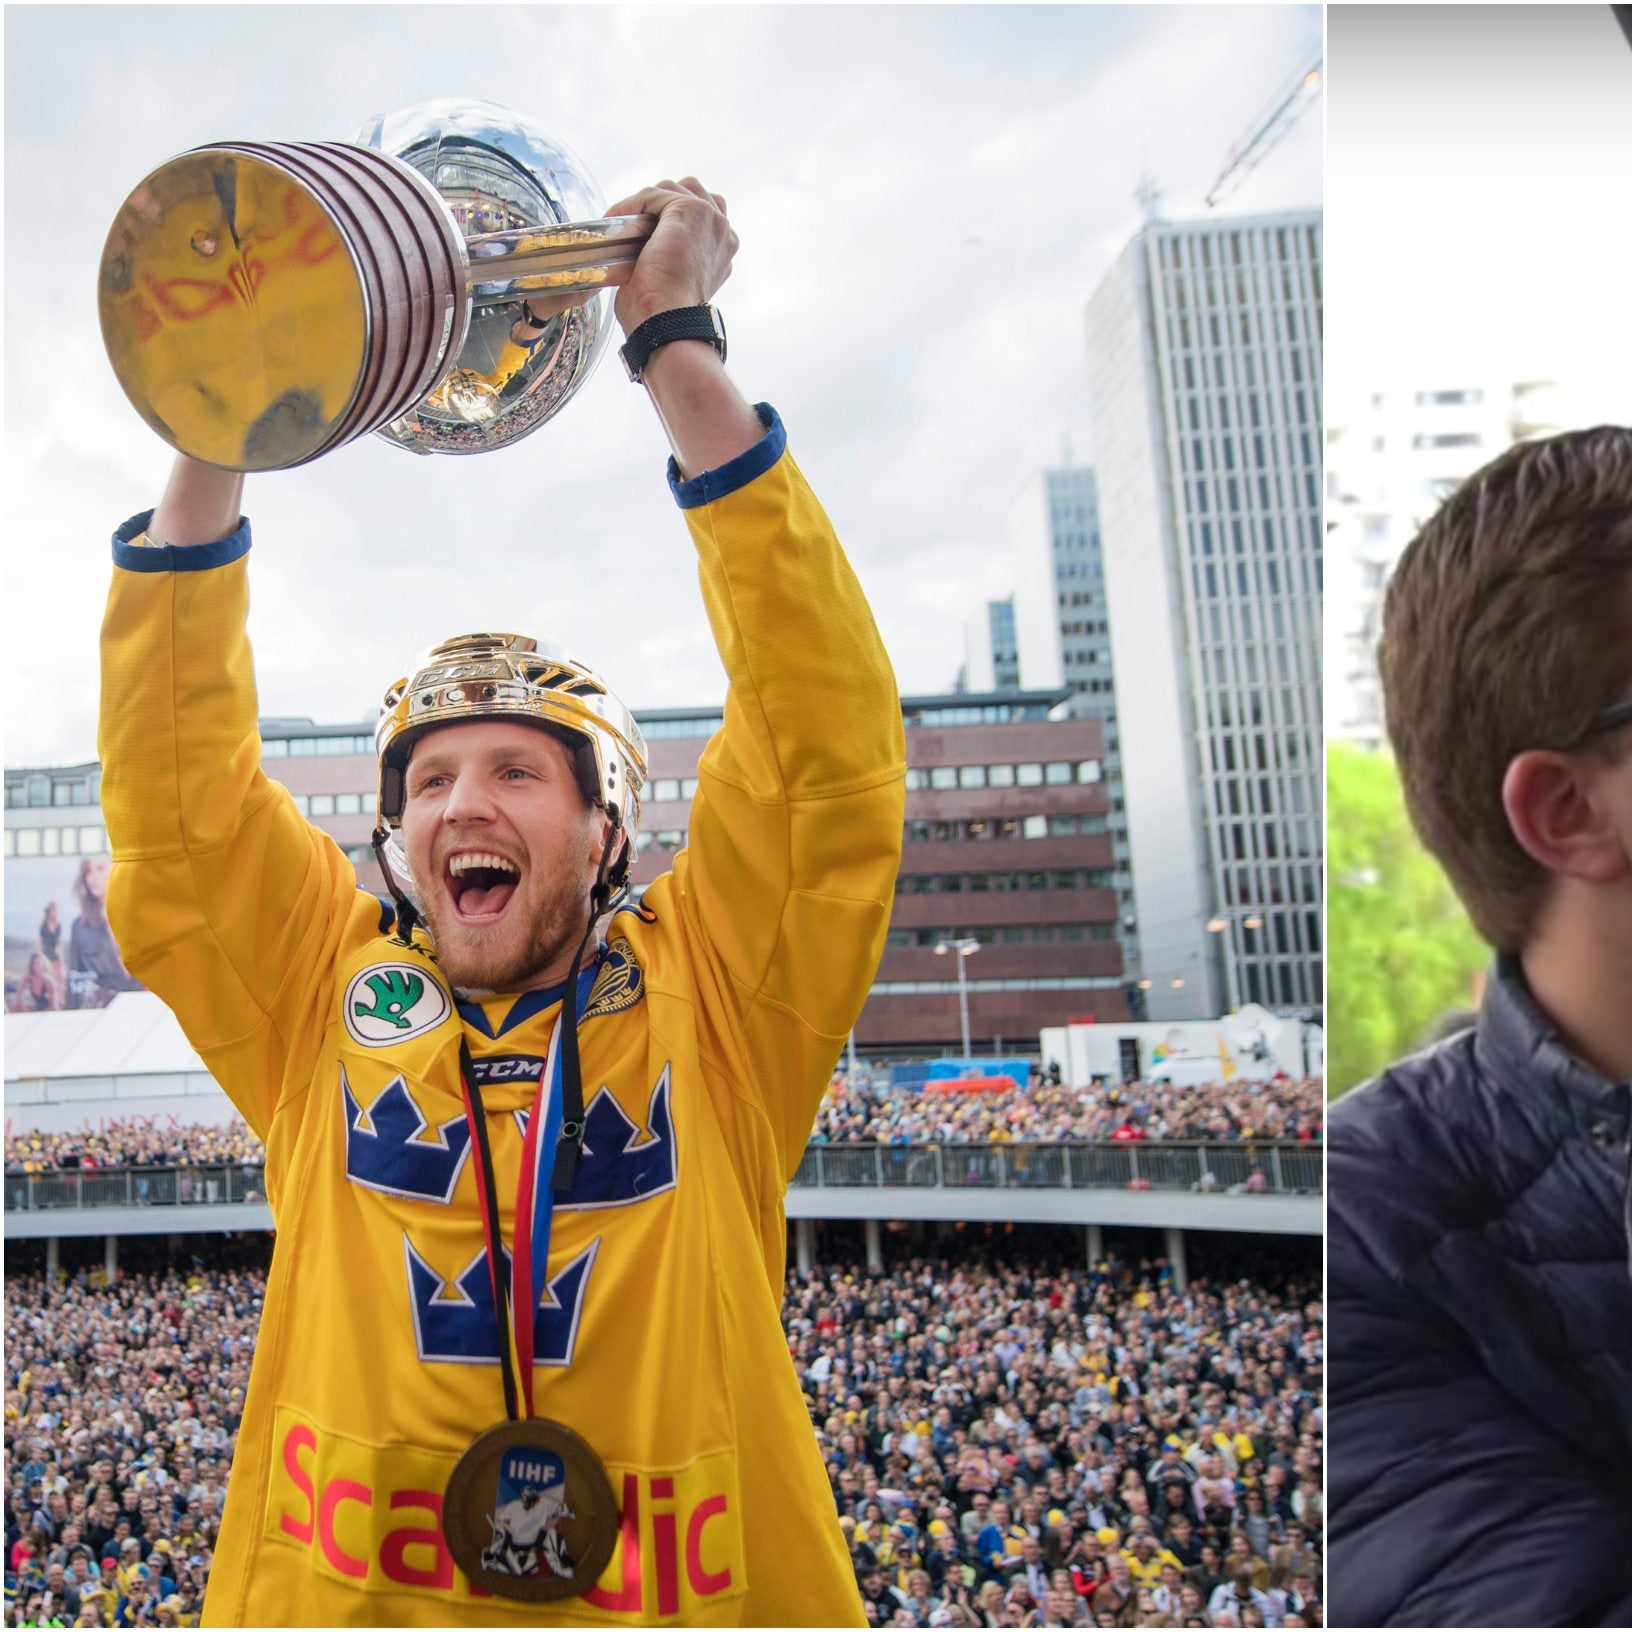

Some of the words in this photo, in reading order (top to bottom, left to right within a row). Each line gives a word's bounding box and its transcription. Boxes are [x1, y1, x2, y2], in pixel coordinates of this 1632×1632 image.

[418, 662, 500, 687] CCM
[508, 1459, 556, 1484] IIHF
[280, 1424, 733, 1618] Scadic
